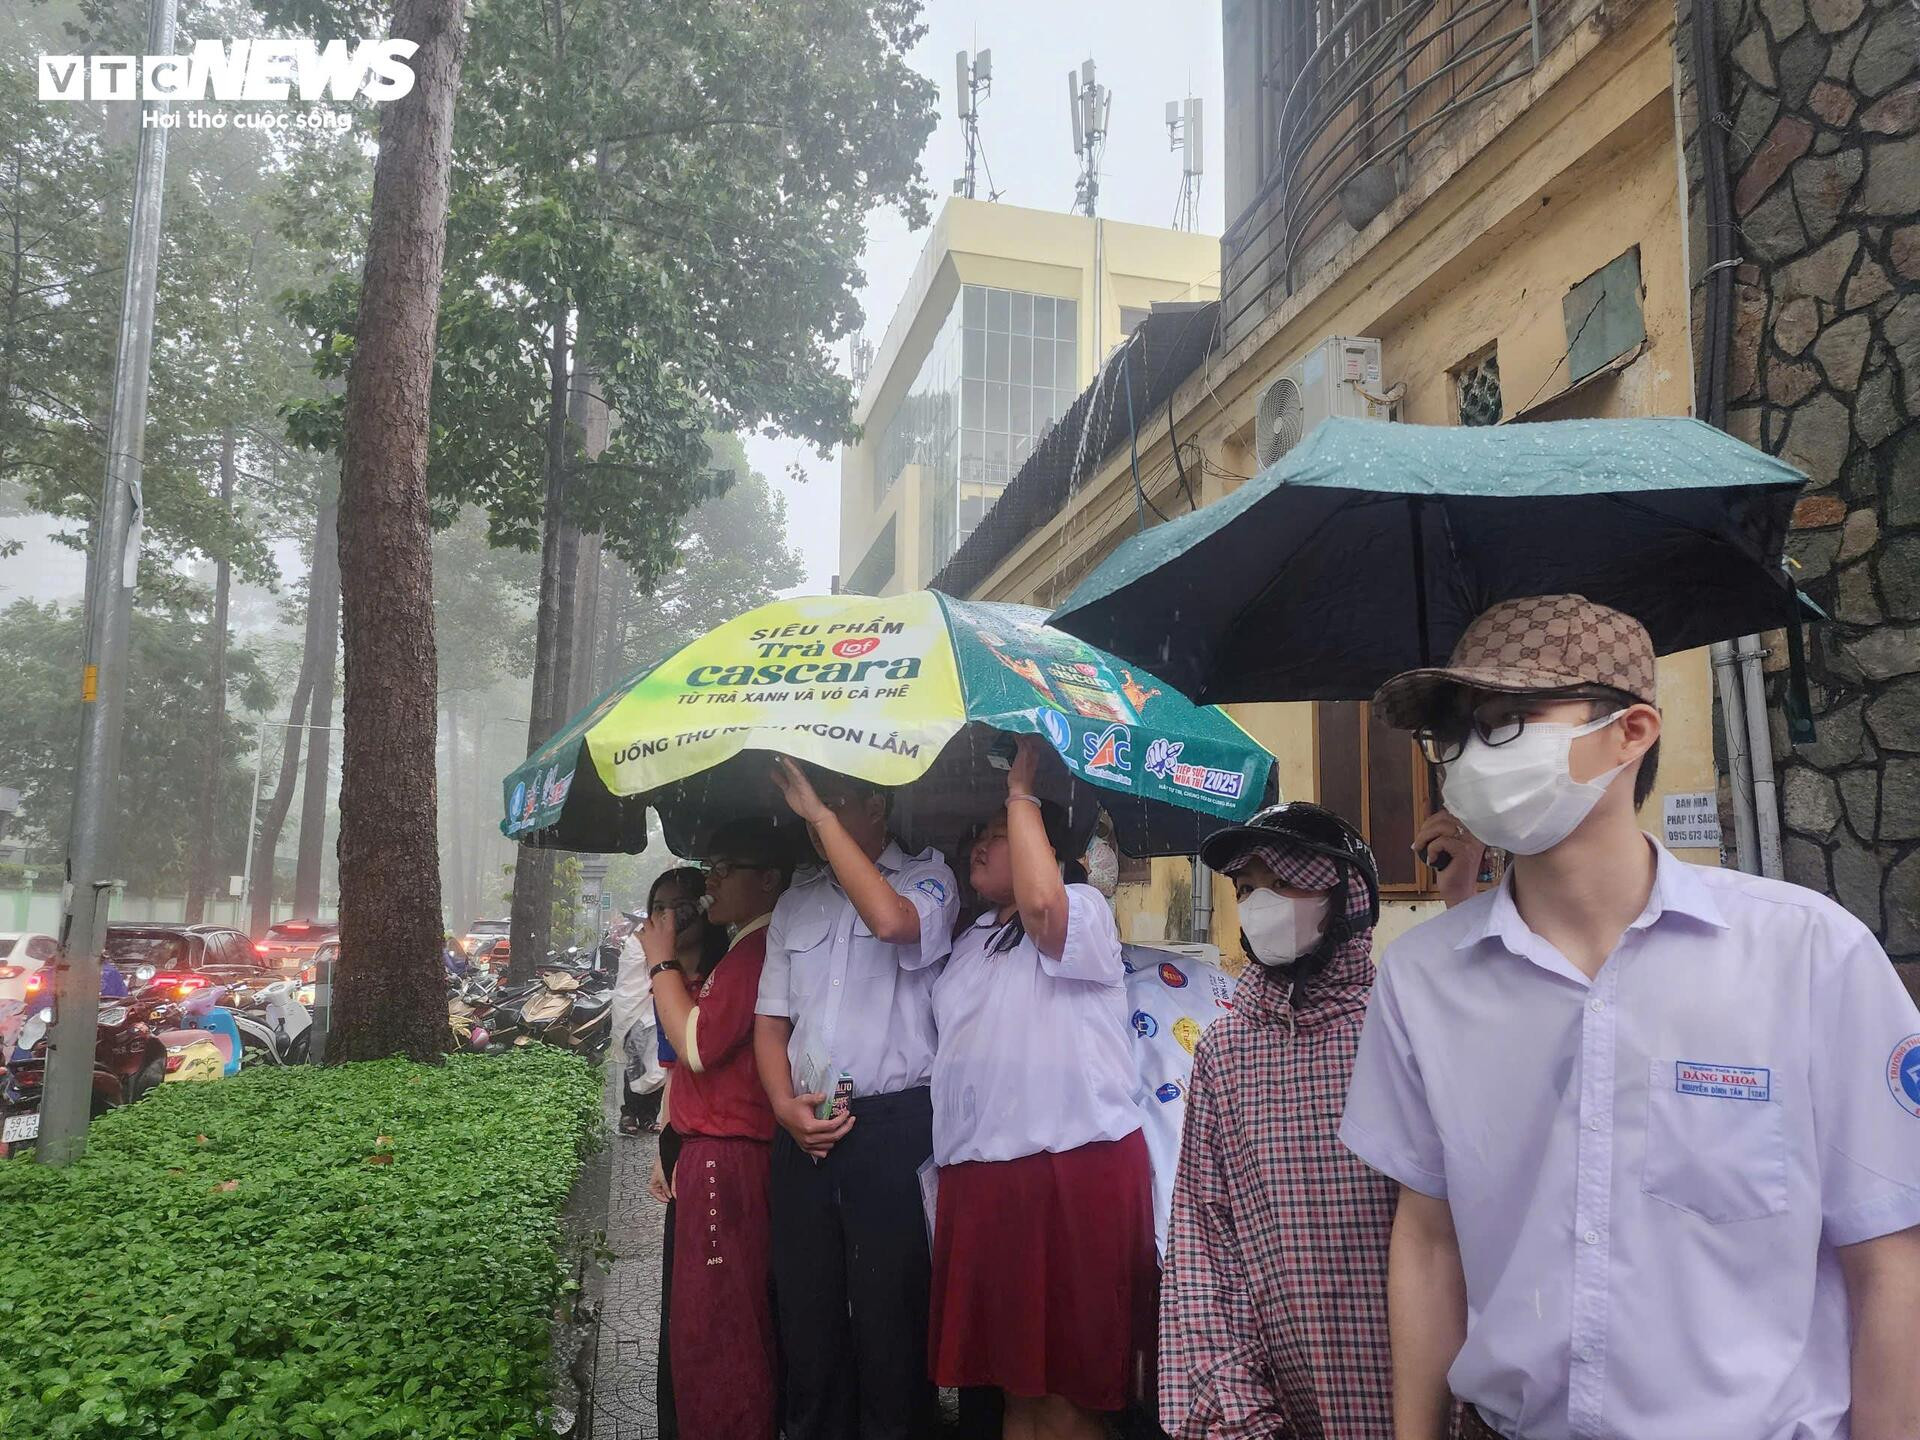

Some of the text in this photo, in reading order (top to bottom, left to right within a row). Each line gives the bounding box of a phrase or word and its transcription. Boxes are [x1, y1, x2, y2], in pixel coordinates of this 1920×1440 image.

[749, 616, 904, 641] SIÊU PHẨM
[757, 640, 825, 658] Trà
[686, 658, 921, 687] cascara
[677, 691, 703, 705] TỪ
[707, 690, 738, 704] TRÀ
[741, 691, 790, 703] XANH
[794, 687, 816, 701] VÀ
[847, 686, 870, 700] CÀ
[875, 684, 910, 698] PHÊ
[613, 738, 669, 766] UỐNG
[868, 732, 920, 759] LẮM
[1204, 771, 1238, 794] 2025
[1722, 1074, 1757, 1085] KHOA
